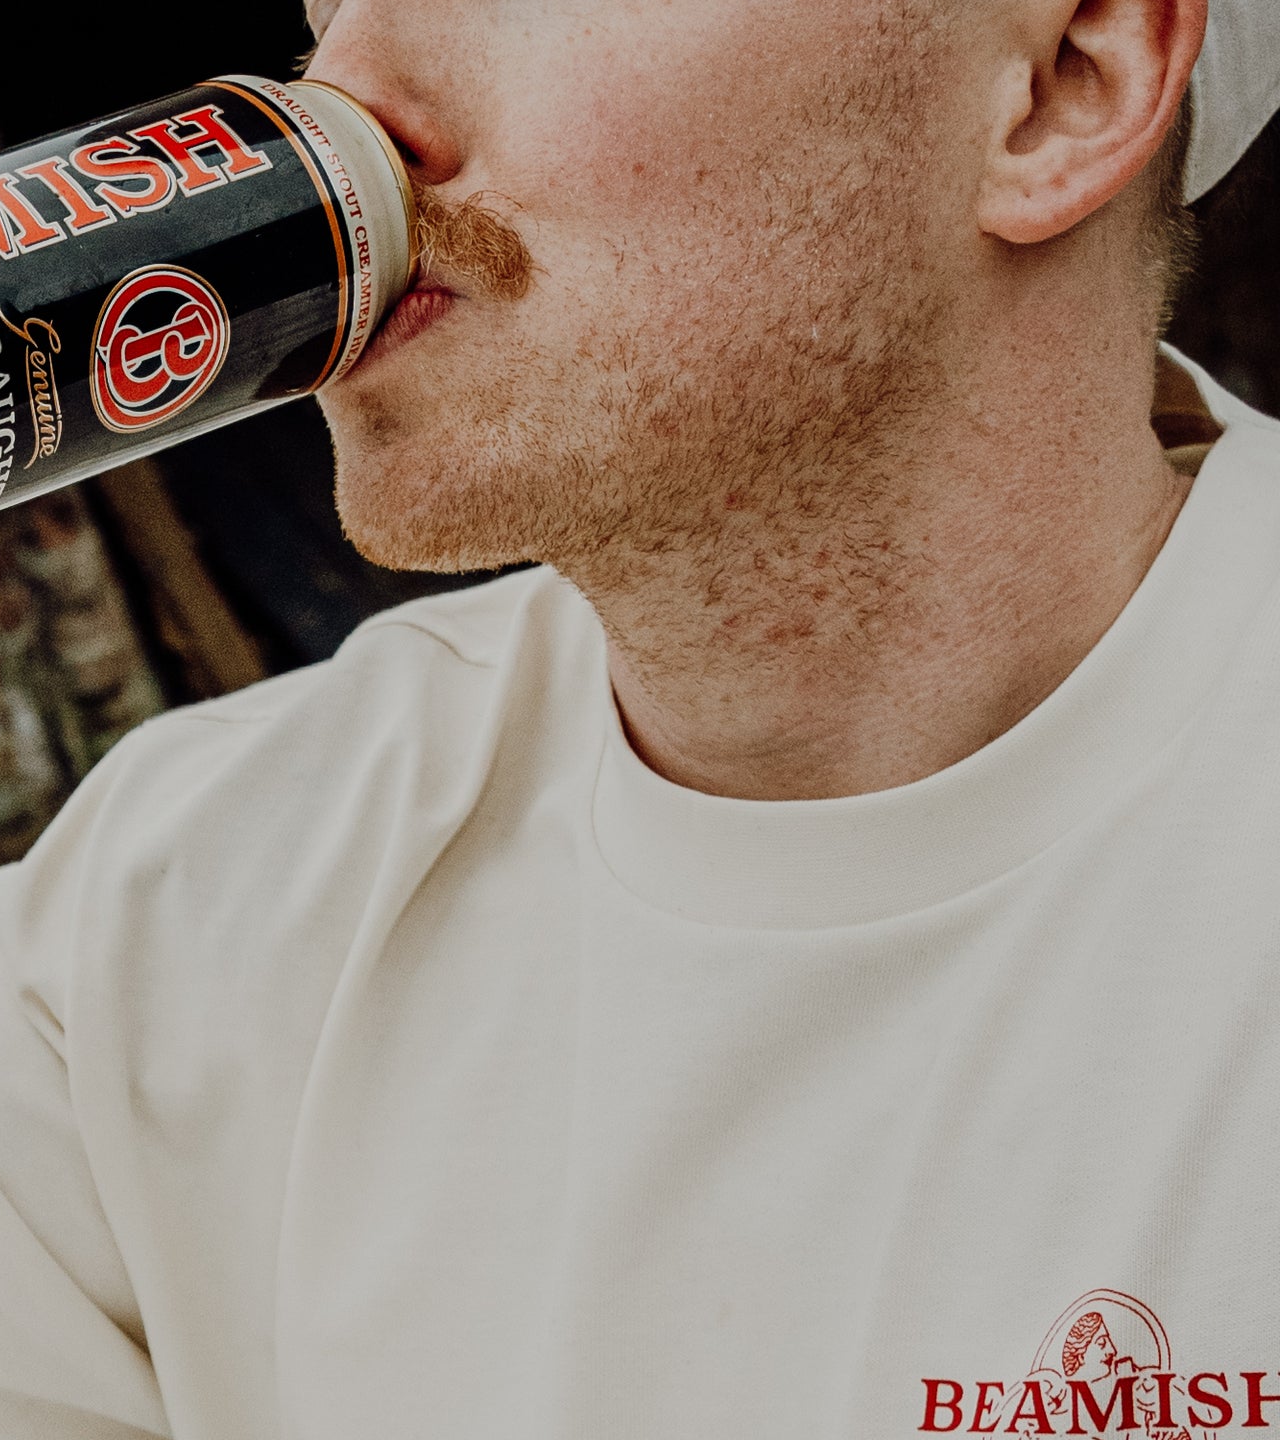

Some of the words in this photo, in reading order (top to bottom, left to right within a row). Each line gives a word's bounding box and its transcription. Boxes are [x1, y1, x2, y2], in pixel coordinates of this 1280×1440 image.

[259, 83, 332, 149] DRAUGHT
[326, 152, 363, 220] STOUT
[354, 224, 372, 333] CREAMIER
[917, 1372, 1280, 1435] BEAMISH
